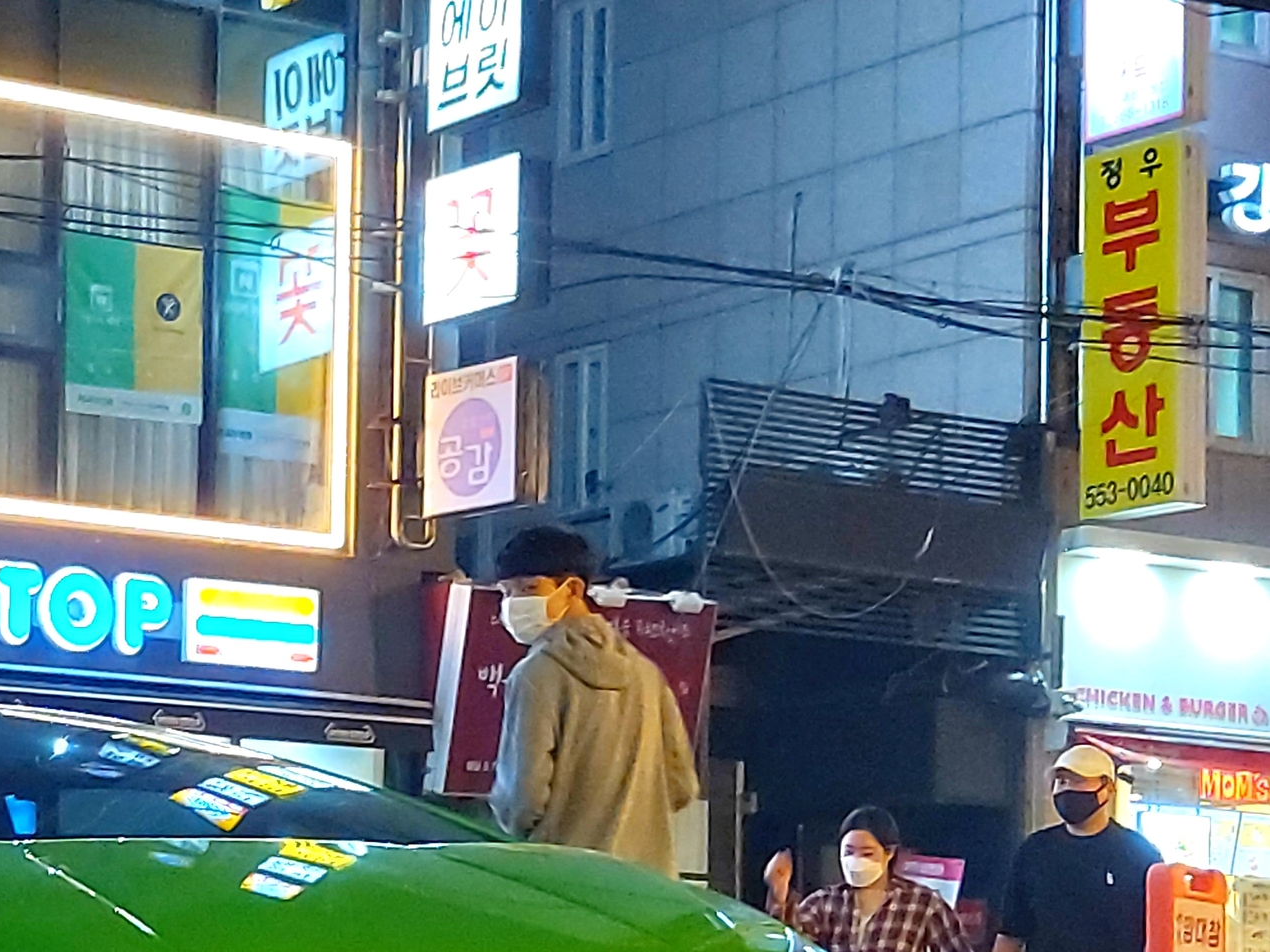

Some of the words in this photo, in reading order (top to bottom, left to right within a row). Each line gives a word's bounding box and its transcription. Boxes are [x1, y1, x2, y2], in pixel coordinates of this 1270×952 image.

[437, 38, 505, 111] 브릿
[1101, 148, 1162, 190] 정우
[1101, 189, 1164, 468] 부동산
[1085, 471, 1174, 509] 553-0040
[1179, 697, 1249, 724] BURGER
